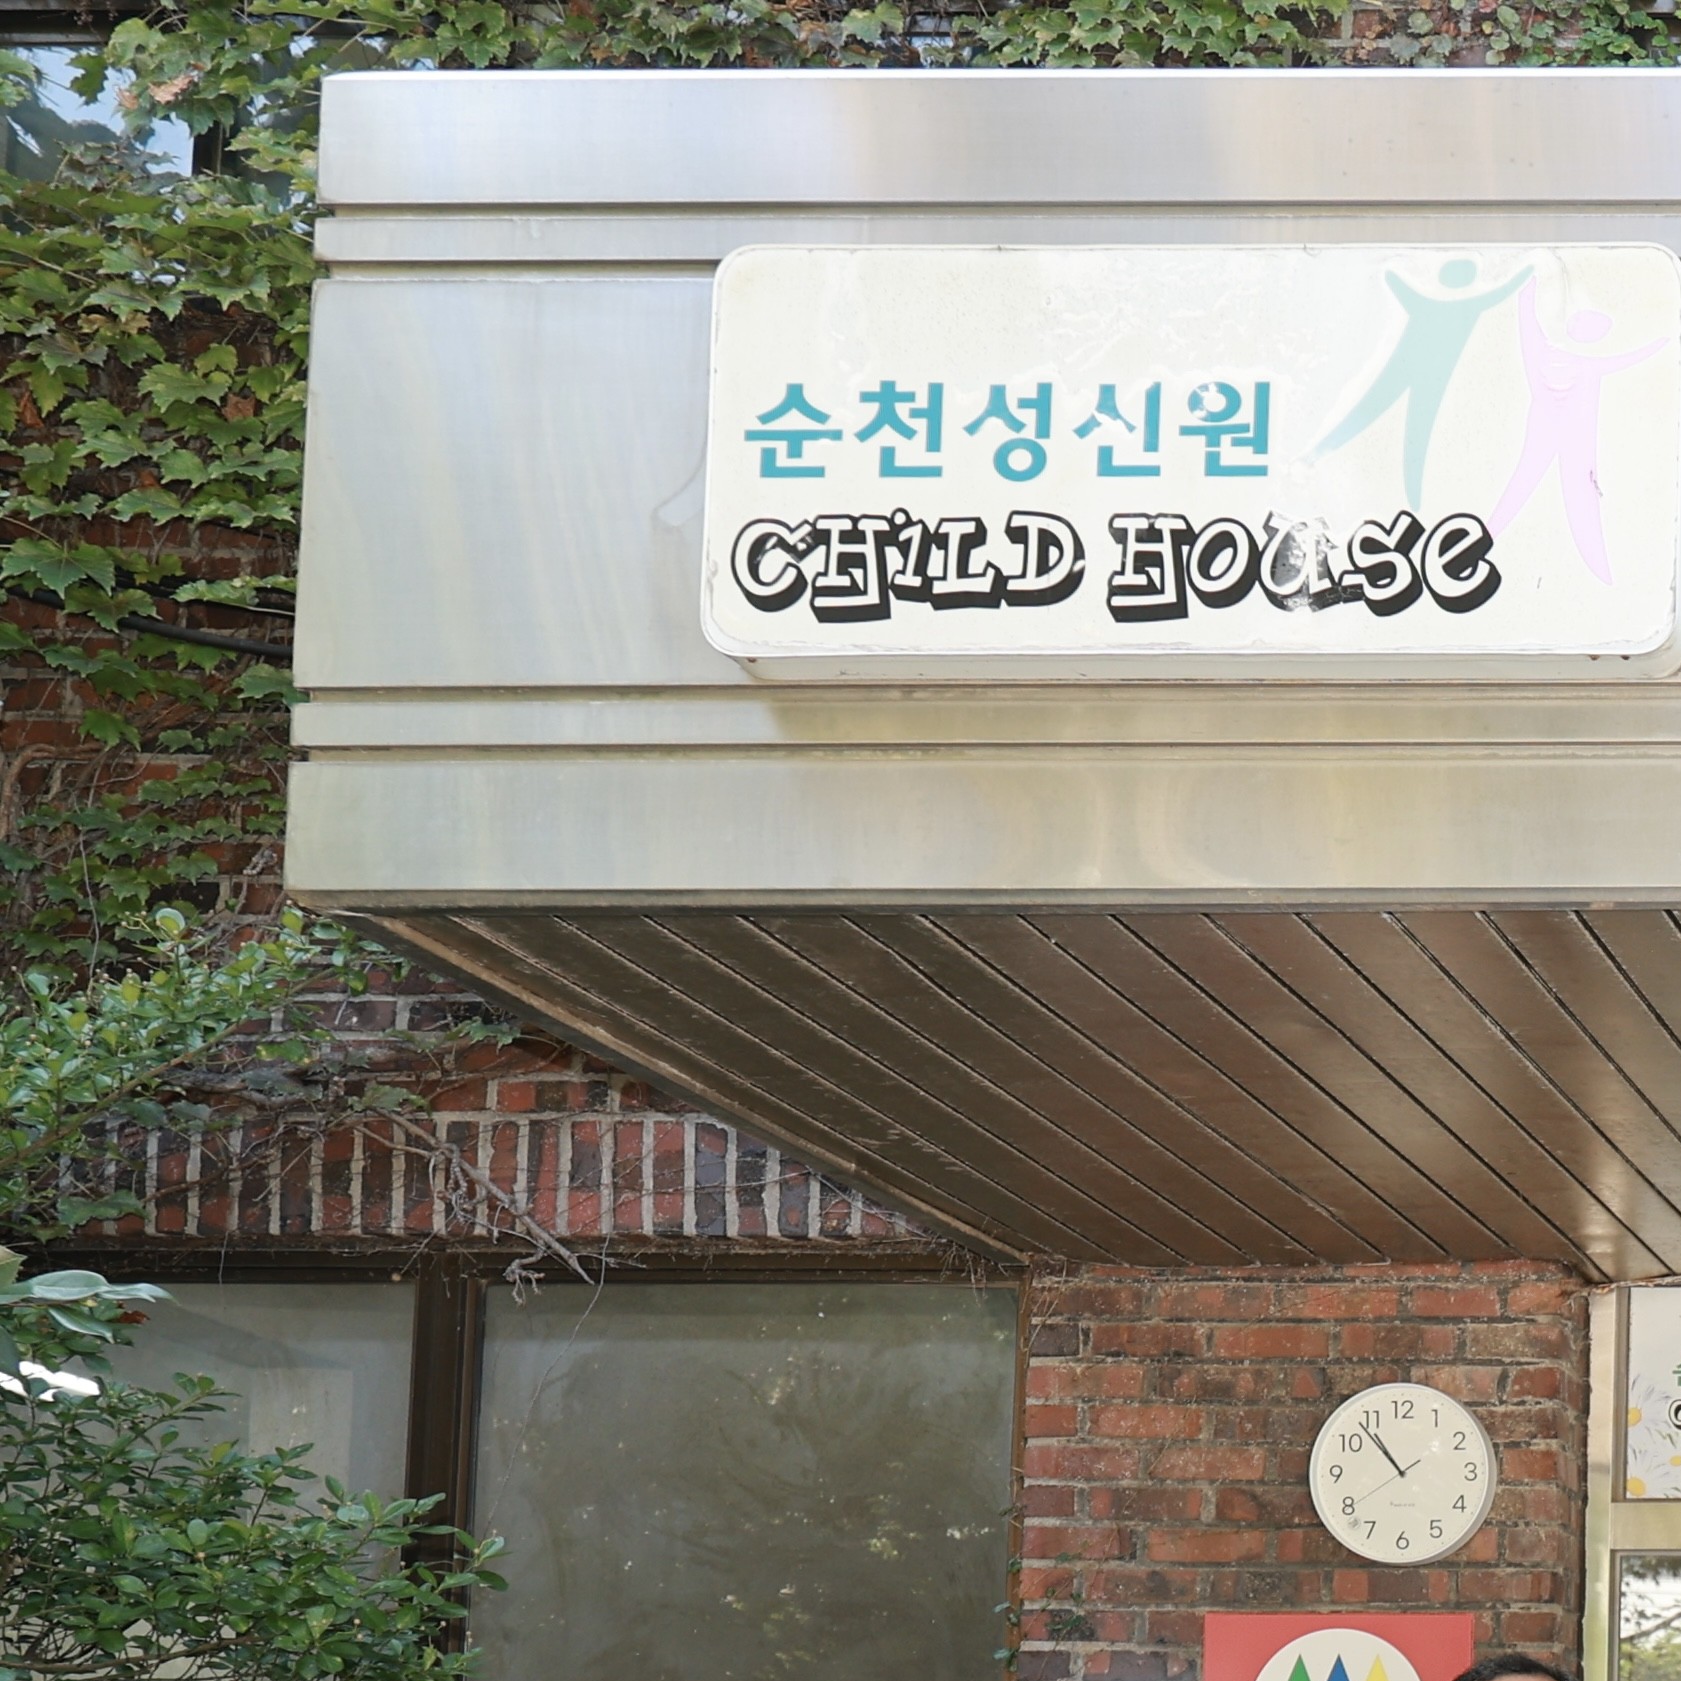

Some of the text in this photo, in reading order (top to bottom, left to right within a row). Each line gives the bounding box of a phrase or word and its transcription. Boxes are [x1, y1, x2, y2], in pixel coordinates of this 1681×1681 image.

[743, 381, 1272, 482] 순천성신원
[1391, 1400, 1414, 1419] 12
[1431, 1409, 1439, 1428] 1
[1363, 1411, 1380, 1429] 11
[1338, 1433, 1363, 1453] 10
[1452, 1431, 1467, 1451] 2
[1329, 1464, 1343, 1484] 9
[1464, 1462, 1478, 1482] 3
[1342, 1496, 1355, 1516] 8
[1452, 1494, 1467, 1513] 4
[1363, 1520, 1376, 1540] 7
[1429, 1519, 1443, 1539] 5
[1395, 1530, 1410, 1550] 6
